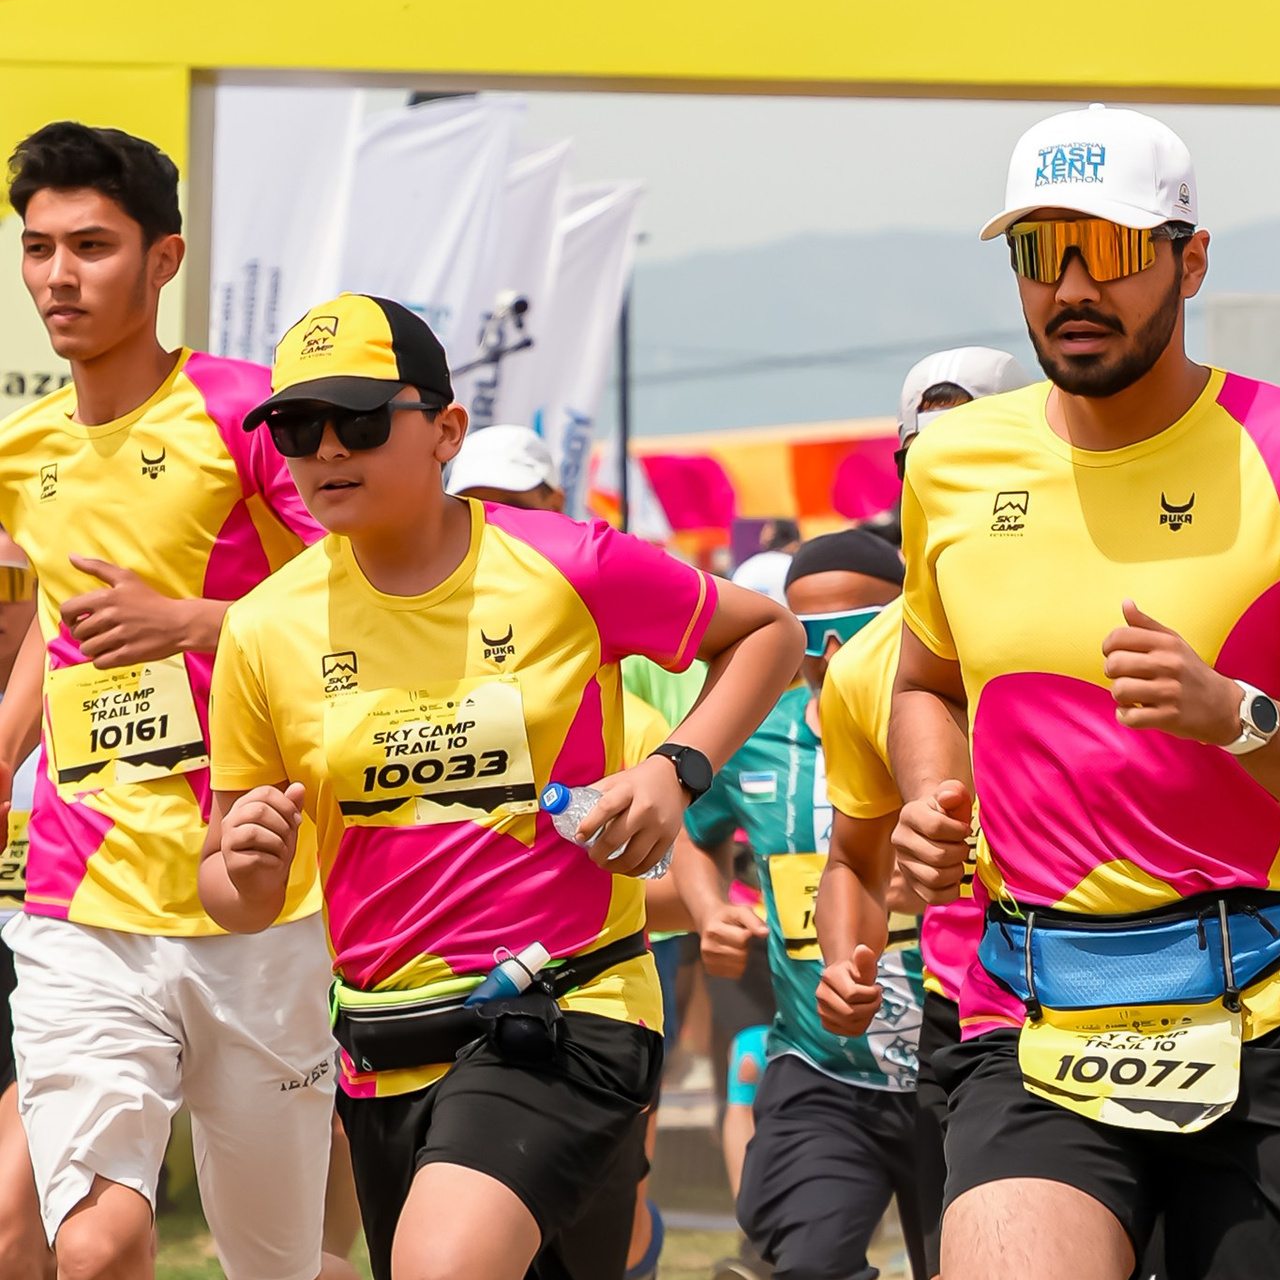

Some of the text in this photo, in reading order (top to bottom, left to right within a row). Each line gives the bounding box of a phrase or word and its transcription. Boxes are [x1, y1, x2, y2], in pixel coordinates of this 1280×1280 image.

[1038, 146, 1106, 169] TASH
[1036, 160, 1101, 180] KENT
[142, 464, 166, 476] BUKA
[990, 524, 1025, 532] CAMP
[995, 515, 1022, 523] SKY
[1159, 513, 1193, 525] BUKA
[484, 645, 515, 659] BUKA
[324, 681, 358, 693] CAMP
[328, 674, 353, 685] SKY
[82, 687, 155, 712] SKY CAMP
[90, 701, 150, 723] TRAIL 10
[90, 714, 168, 753] 10161
[372, 720, 476, 745] SKY CAMP
[384, 736, 468, 757] TRAIL 10
[363, 749, 509, 792] 10033
[1085, 1040, 1176, 1052] TRAIL 10
[1054, 1055, 1217, 1090] 10077
